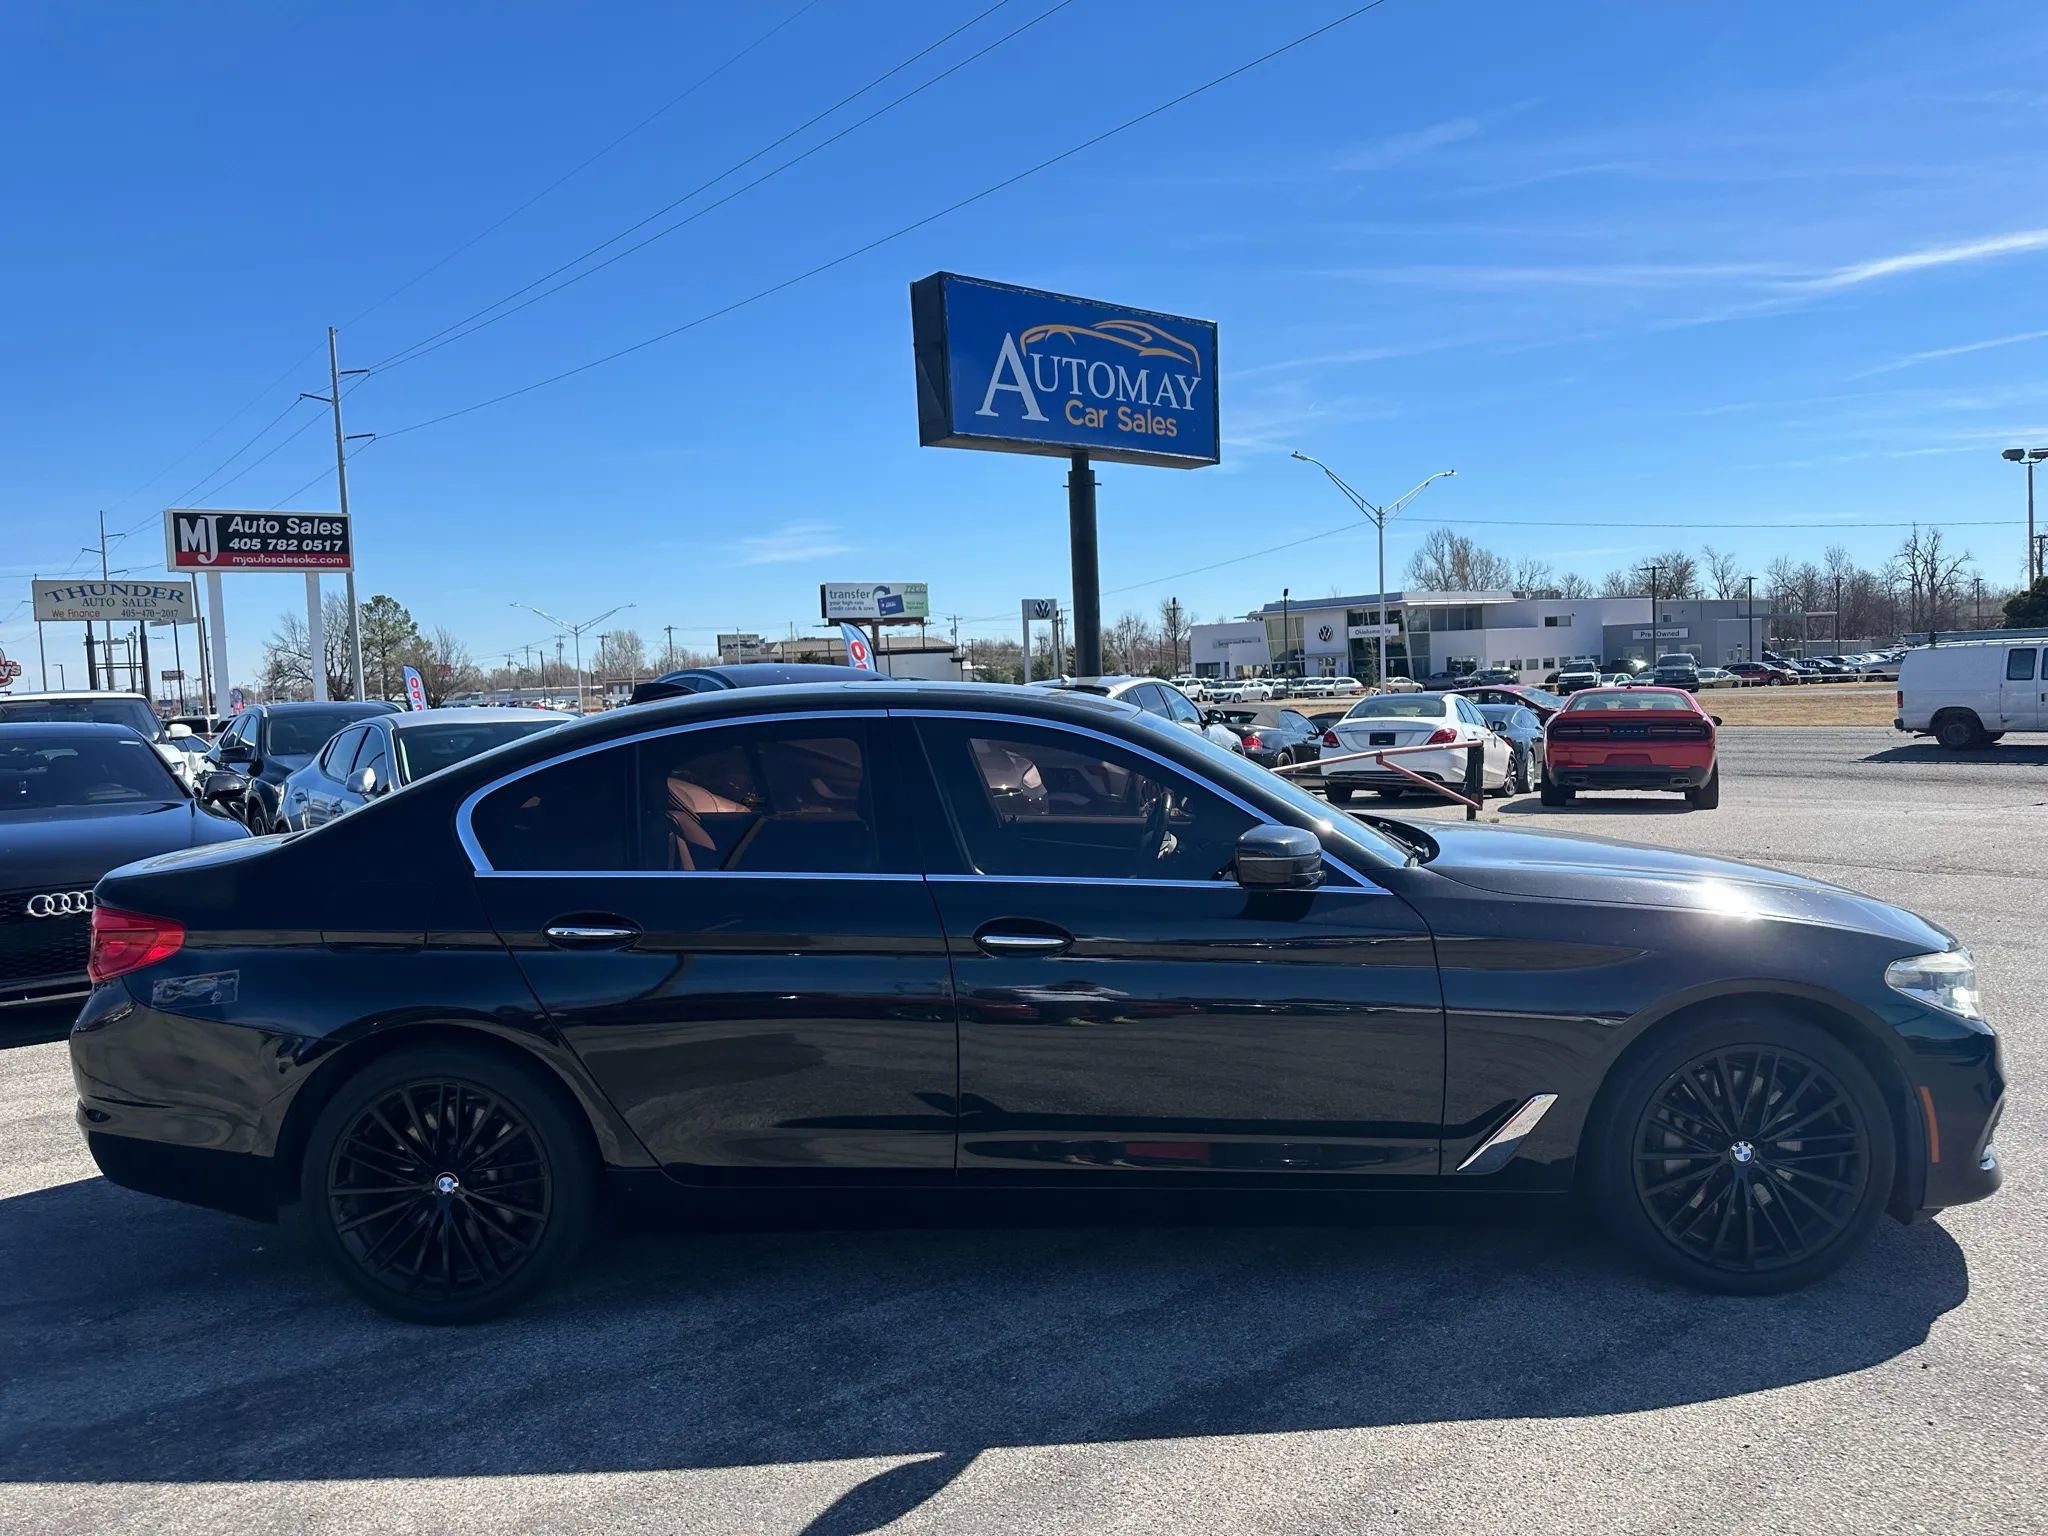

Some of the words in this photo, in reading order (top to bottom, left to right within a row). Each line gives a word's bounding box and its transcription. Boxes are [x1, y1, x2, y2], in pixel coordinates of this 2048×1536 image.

[975, 332, 1202, 422] AUTOMAY
[1065, 399, 1108, 428] Car
[1117, 406, 1178, 437] Sales
[228, 516, 279, 533] Auto
[286, 517, 343, 535] Sales
[179, 515, 223, 564] MJ
[228, 538, 261, 550] 405
[267, 539, 298, 551] 782
[302, 540, 343, 552] 0517
[232, 553, 344, 566] mjautosalesokc.com
[44, 583, 185, 604] THUNDER
[829, 588, 870, 599] transfer
[82, 598, 115, 607] AUTO
[122, 598, 157, 608] SALES
[51, 609, 64, 617] We
[68, 609, 100, 617] Finance
[121, 609, 178, 618] 405-470-2017
